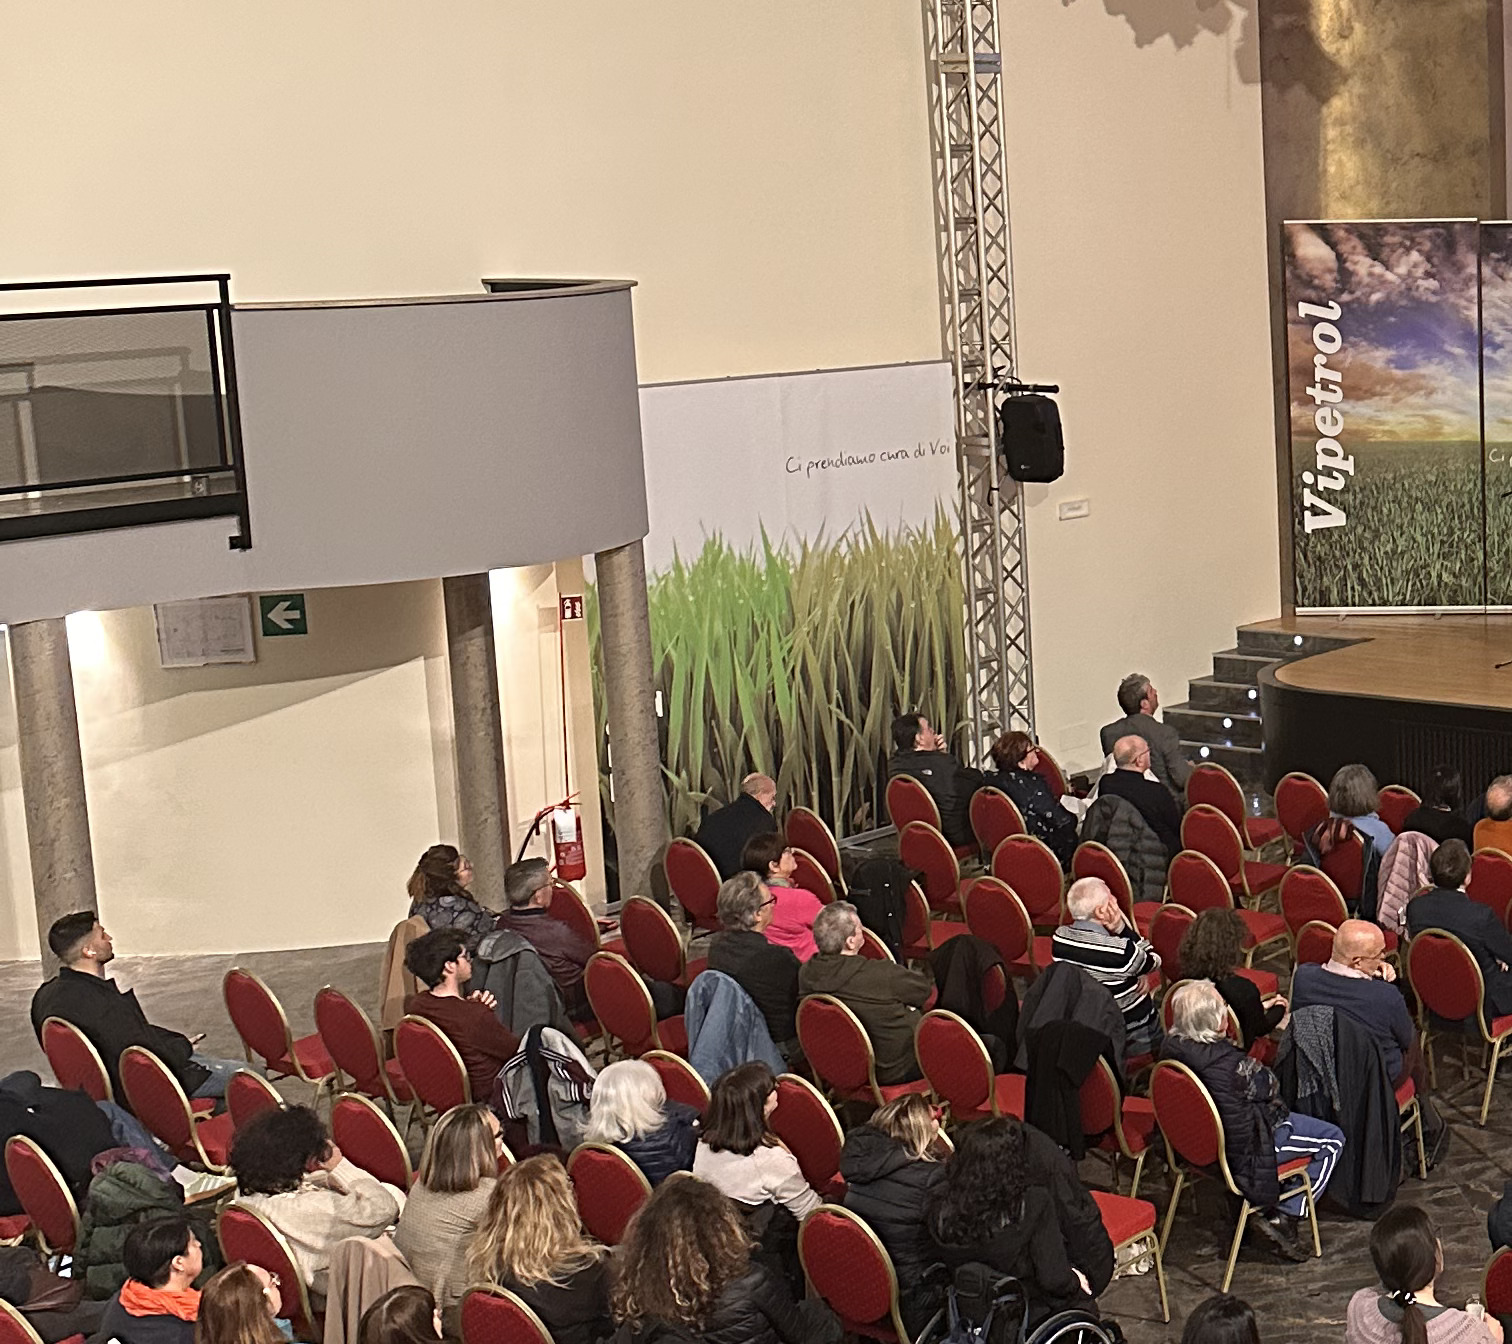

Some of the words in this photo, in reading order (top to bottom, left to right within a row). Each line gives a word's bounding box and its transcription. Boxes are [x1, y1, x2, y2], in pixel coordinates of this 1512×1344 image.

[1297, 299, 1356, 535] Vipetrol
[785, 457, 802, 474] Ci
[806, 450, 876, 479] prendiamo
[880, 450, 910, 462] cura
[914, 442, 926, 459] di
[929, 438, 950, 456] Voi
[1488, 448, 1505, 462] Ci
